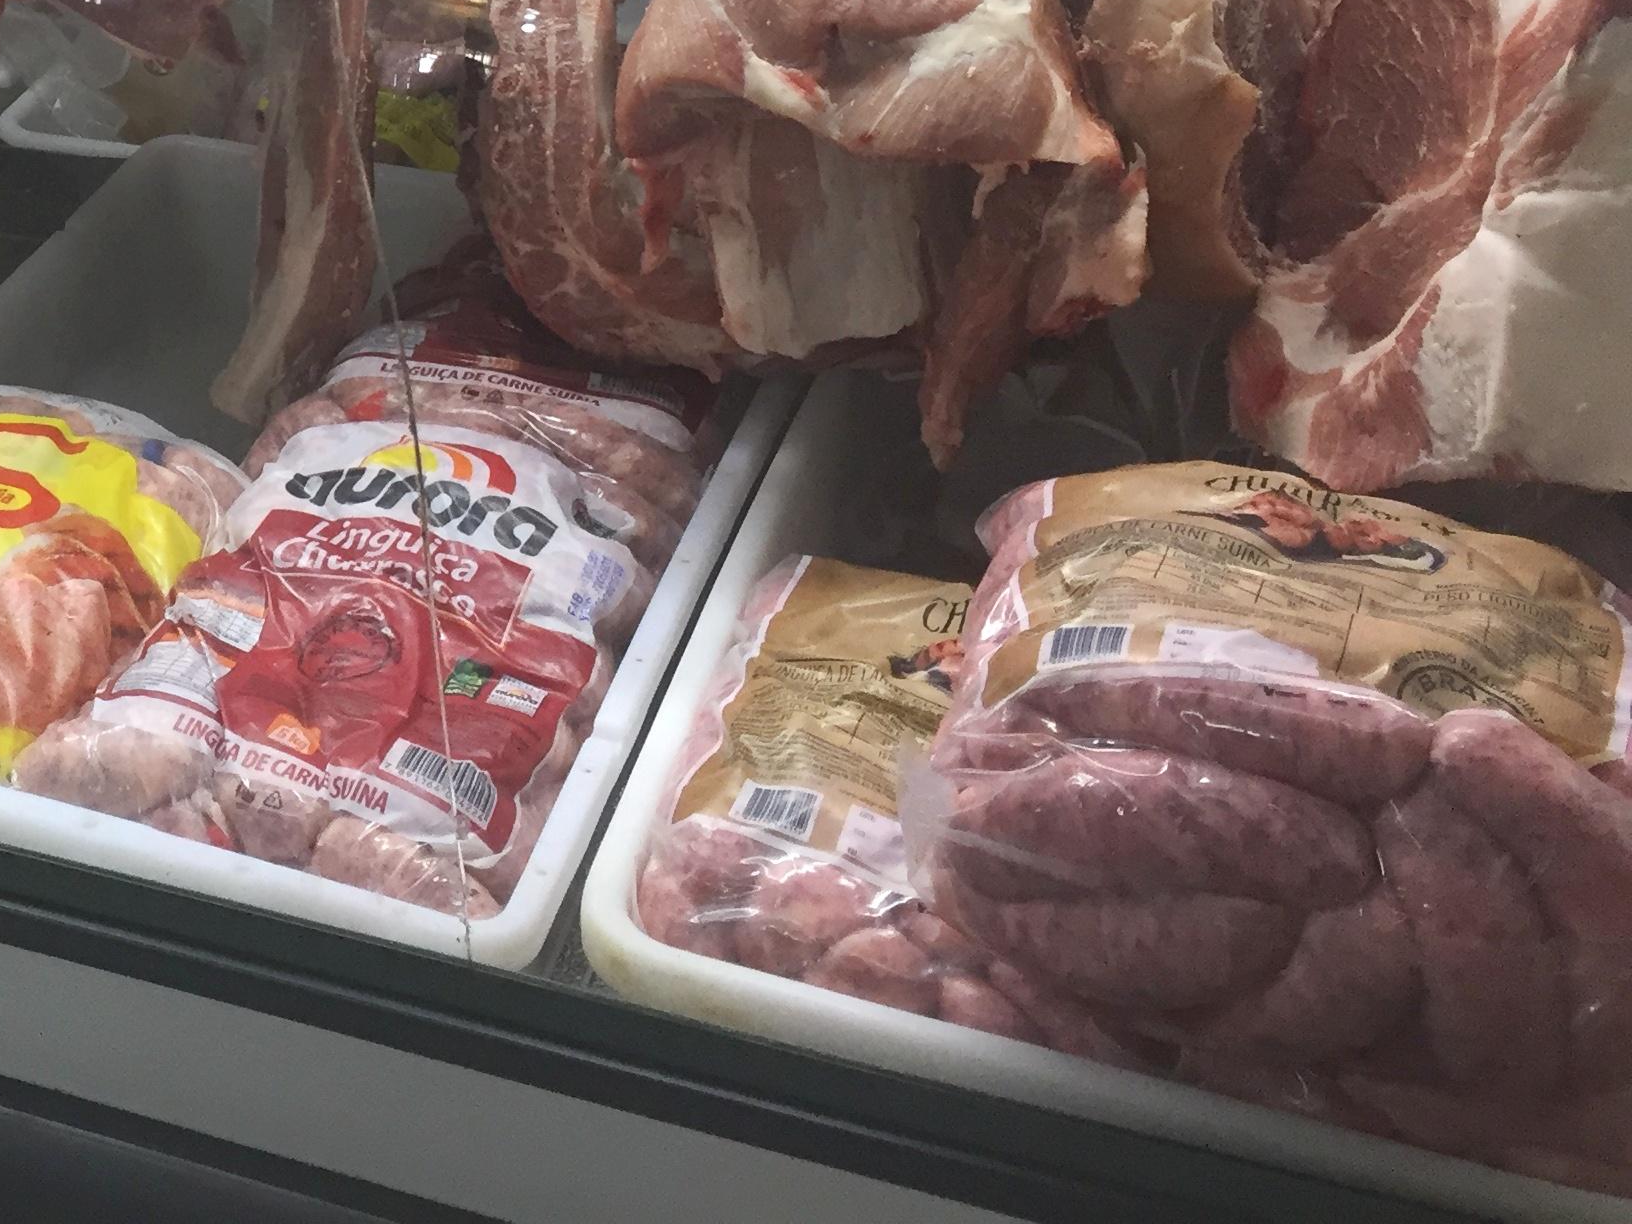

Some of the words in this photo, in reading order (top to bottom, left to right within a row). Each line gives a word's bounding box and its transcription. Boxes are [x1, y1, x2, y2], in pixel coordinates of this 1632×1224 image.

[461, 371, 484, 383] DE
[487, 374, 545, 396] CARNE
[284, 466, 559, 557] aurora
[836, 664, 859, 682] DE
[240, 749, 272, 772] DE
[269, 758, 330, 791] CARNE
[329, 774, 390, 815] SUÍNA
